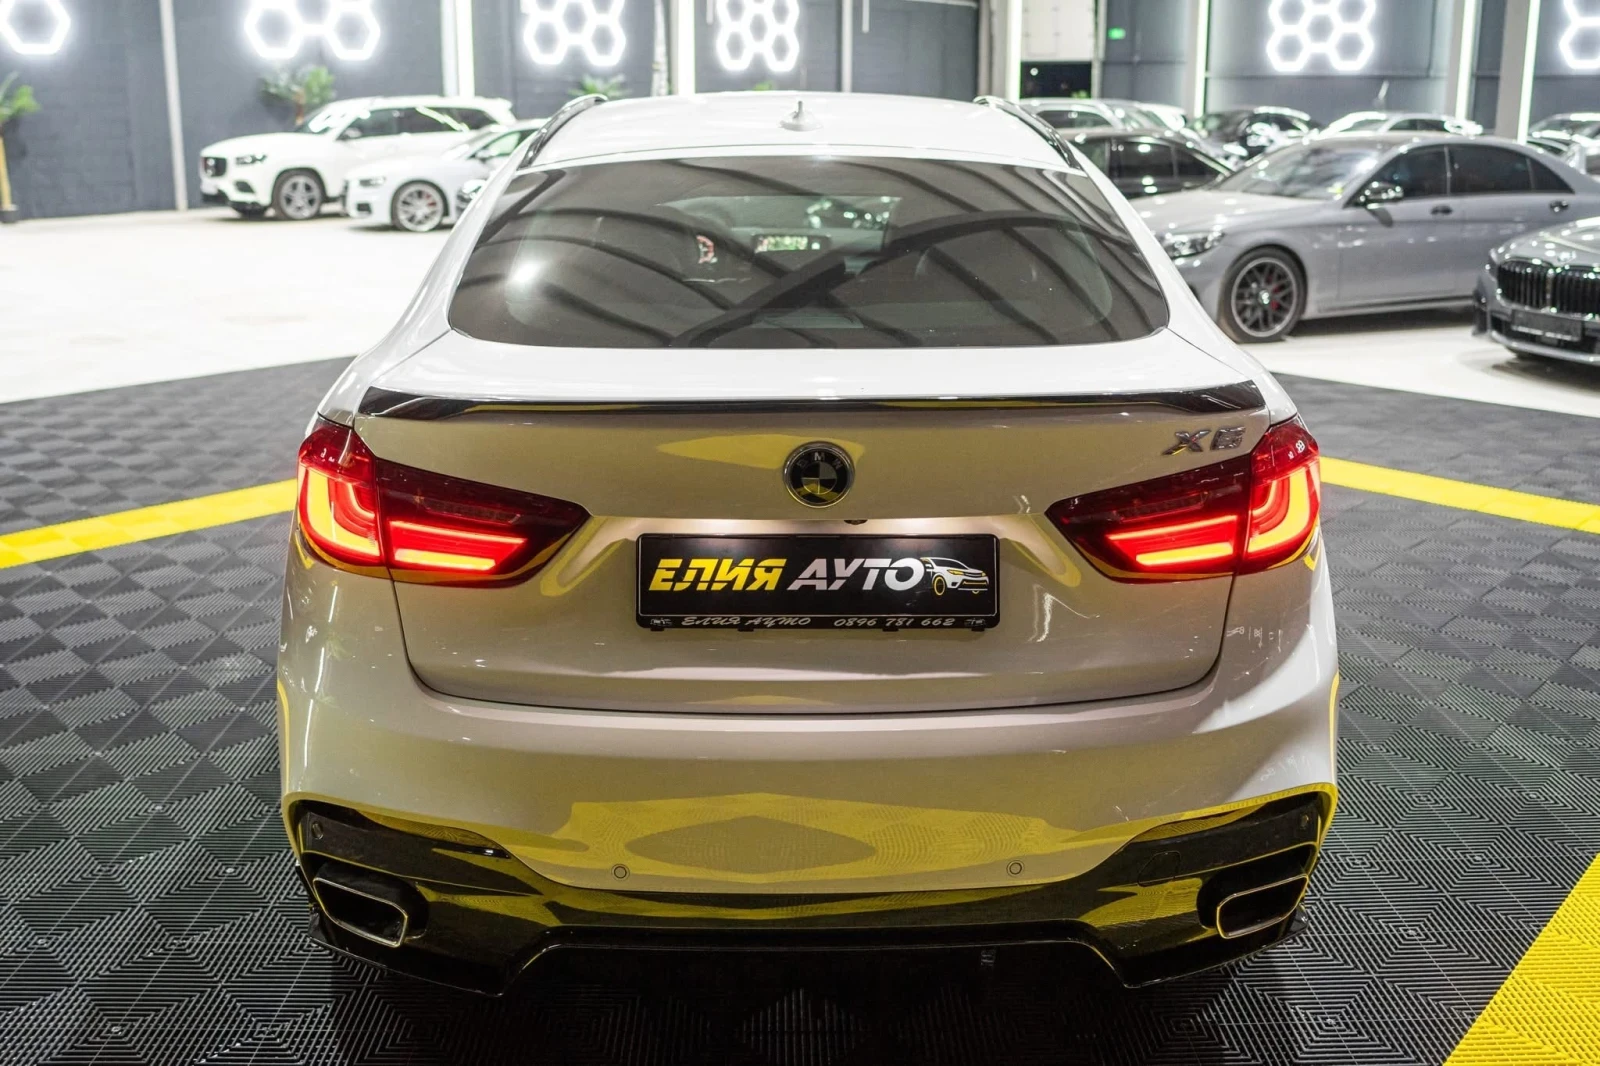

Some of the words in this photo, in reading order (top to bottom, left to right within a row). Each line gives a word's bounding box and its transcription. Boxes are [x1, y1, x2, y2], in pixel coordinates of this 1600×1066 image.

[1161, 426, 1246, 455] X6
[796, 451, 843, 471] BMW
[649, 558, 787, 591] ЕЛИЯ
[787, 557, 925, 591] АУТО
[833, 617, 878, 627] 0896
[884, 617, 915, 627] 781
[920, 617, 956, 627] 662
